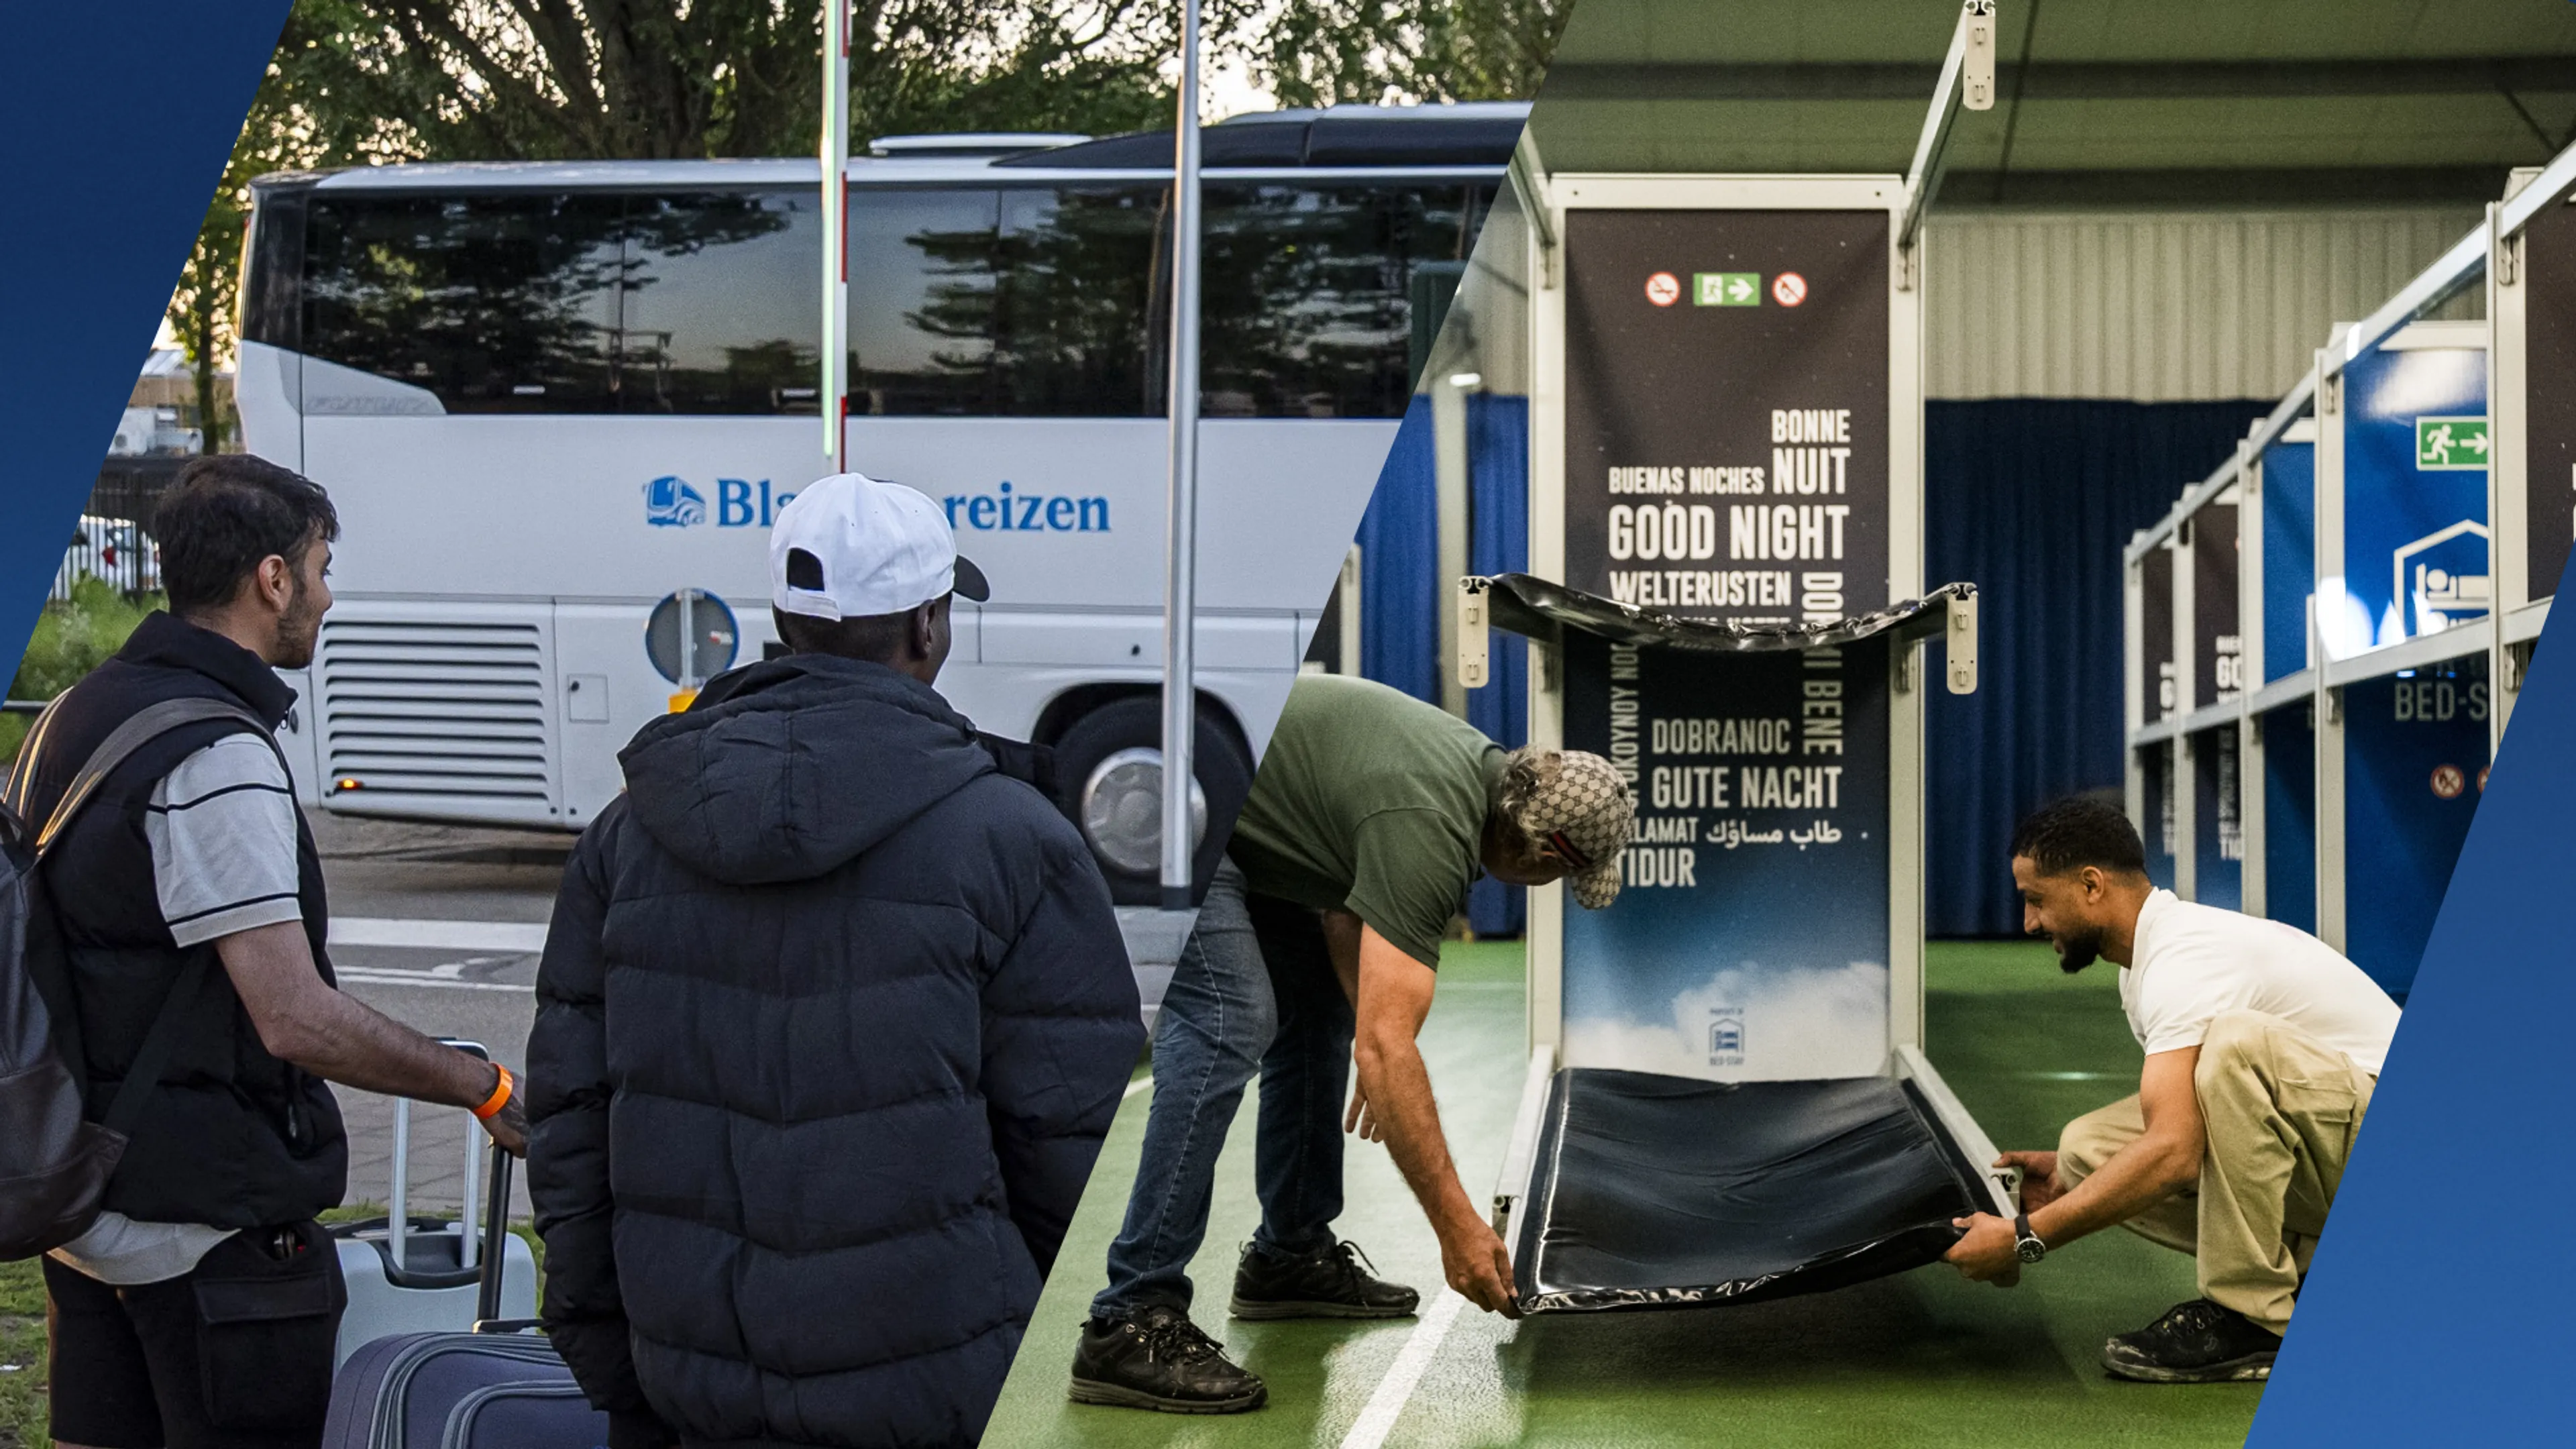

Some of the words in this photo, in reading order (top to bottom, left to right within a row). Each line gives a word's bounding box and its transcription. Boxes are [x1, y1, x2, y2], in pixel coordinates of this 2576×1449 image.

[1771, 409, 1851, 443] BONNE
[1609, 466, 1684, 494] BUENAS
[1689, 466, 1765, 495] NOCHES
[1772, 447, 1851, 495] NUIT
[943, 480, 1111, 531] reizen
[1609, 504, 1715, 561] GOOD
[1729, 504, 1850, 561] NIGHT
[1609, 570, 1792, 607] WELTERUSTEN
[1652, 718, 1790, 755] DOBRANOC
[1803, 680, 1843, 755] BENE
[1652, 766, 1729, 810] GUTE
[1741, 766, 1842, 809] NACHT
[1789, 820, 1843, 851] طاب
